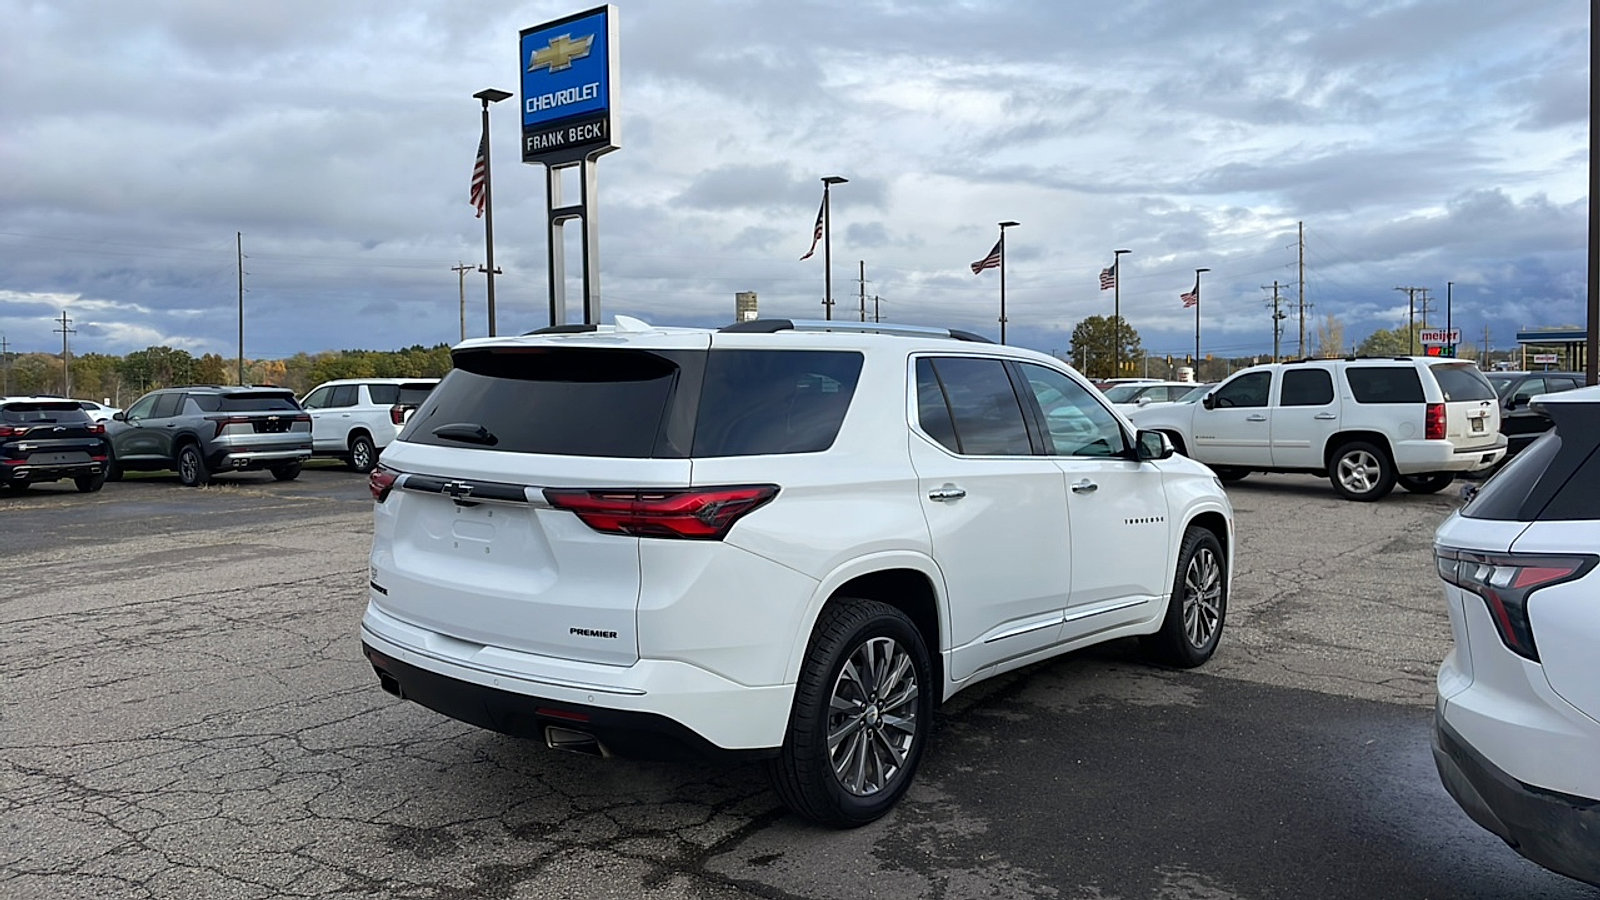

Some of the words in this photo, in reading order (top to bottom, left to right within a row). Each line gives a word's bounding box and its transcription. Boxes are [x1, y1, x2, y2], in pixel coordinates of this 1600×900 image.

[526, 82, 600, 113] CHEVROLET
[527, 130, 565, 151] FRANK
[568, 123, 602, 142] BECK
[569, 627, 618, 639] PREMIER
